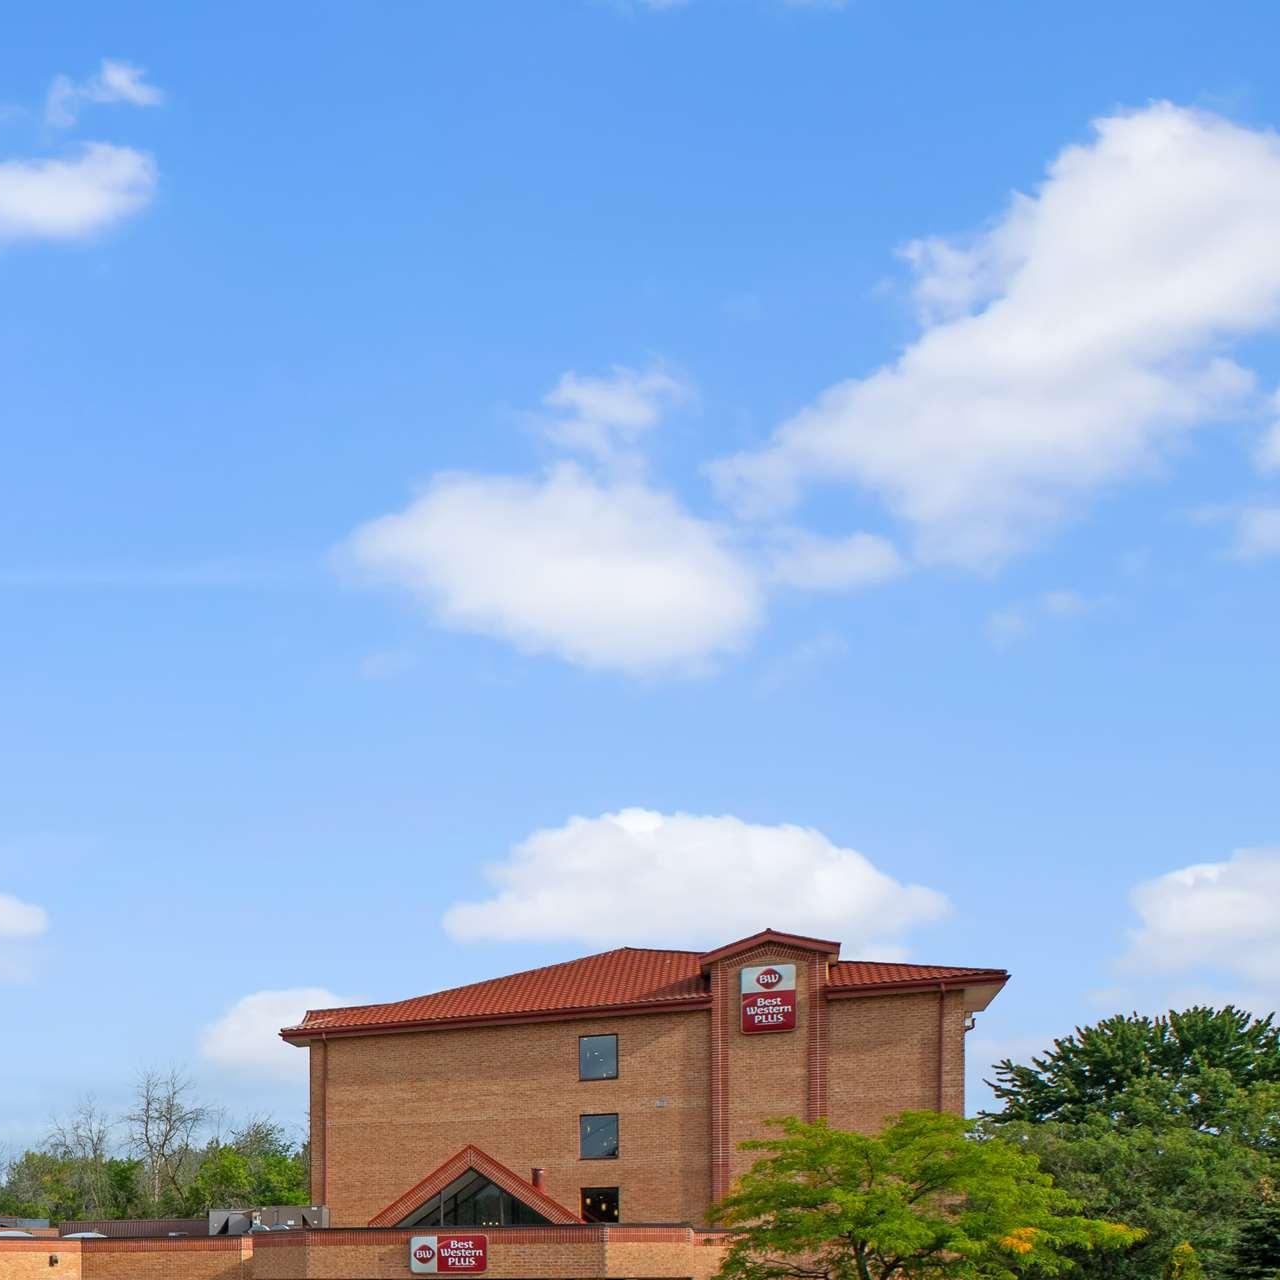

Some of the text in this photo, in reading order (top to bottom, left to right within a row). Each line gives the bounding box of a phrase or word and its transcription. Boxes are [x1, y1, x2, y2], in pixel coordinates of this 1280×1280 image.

[759, 974, 779, 984] BW
[757, 997, 782, 1006] Best
[746, 1005, 792, 1015] Western
[450, 1240, 474, 1248] Best
[440, 1248, 483, 1257] Western
[448, 1257, 475, 1266] PLUS
